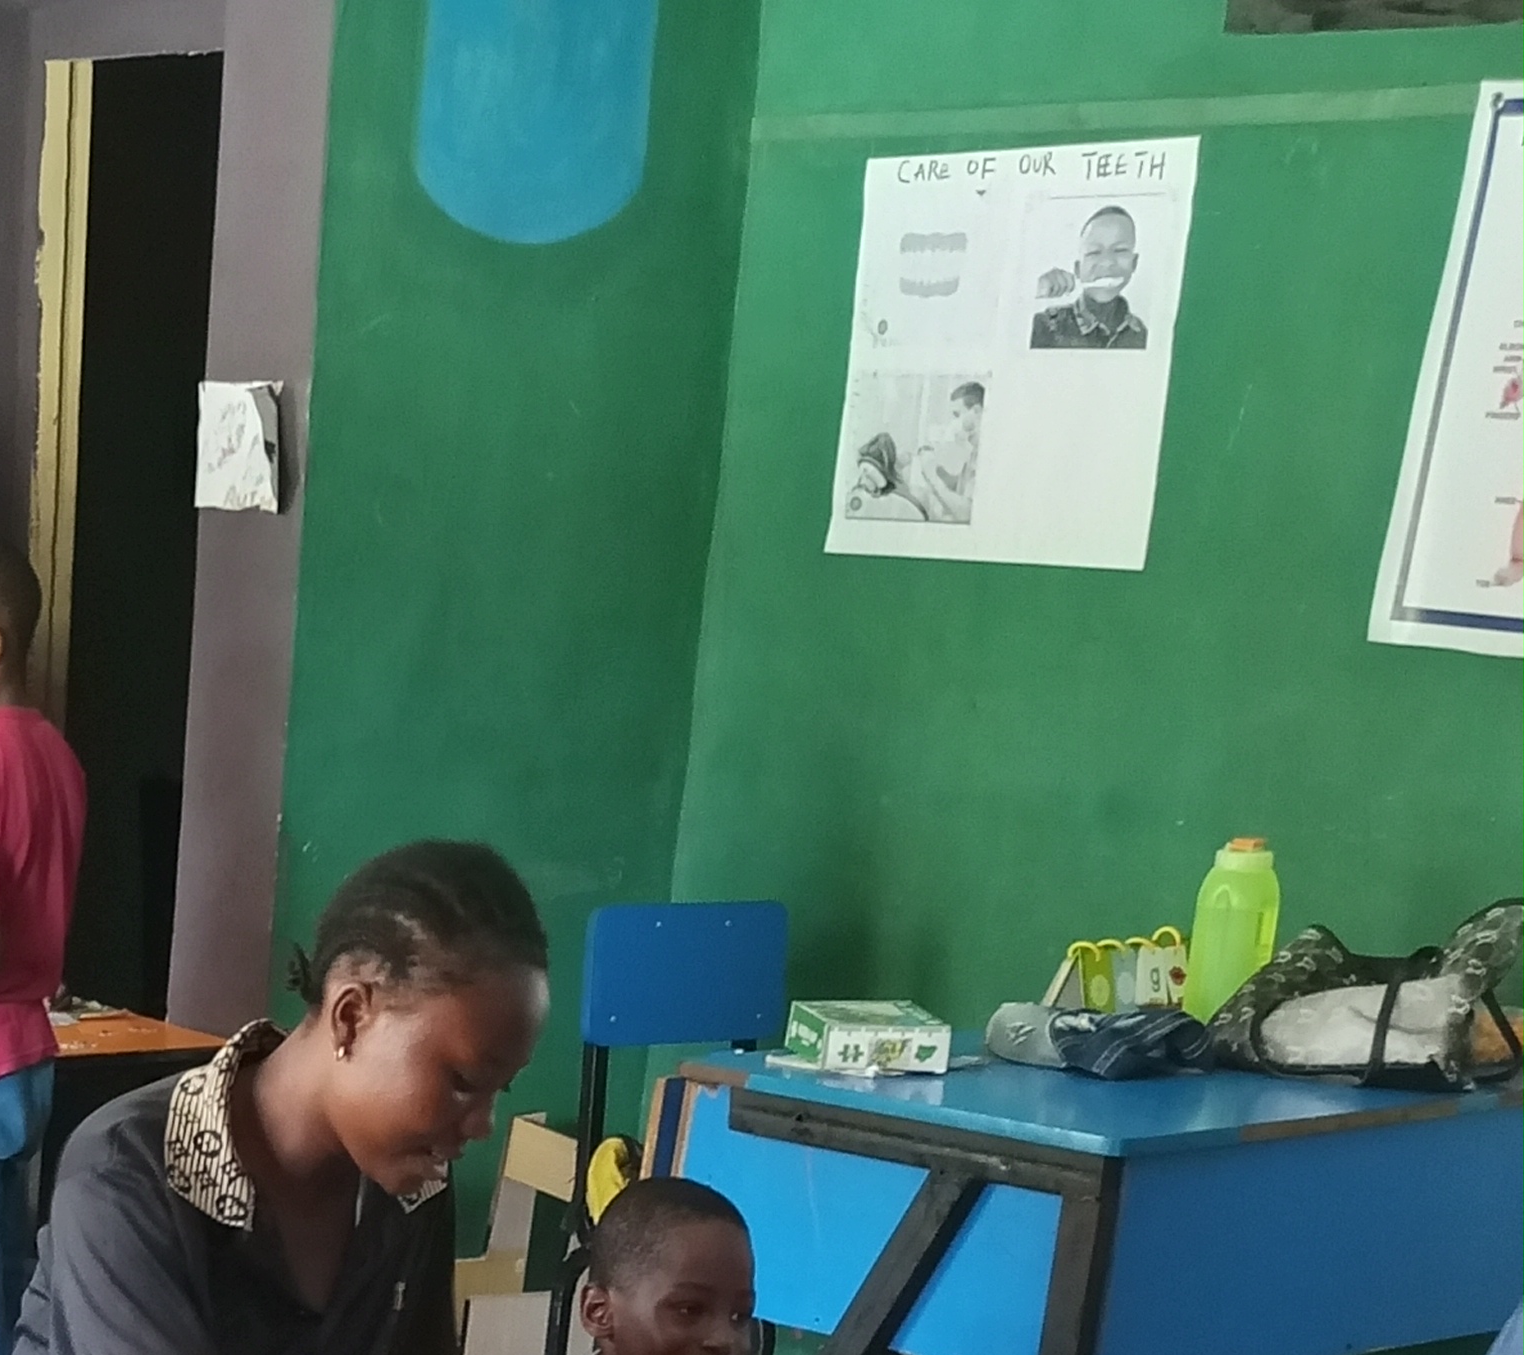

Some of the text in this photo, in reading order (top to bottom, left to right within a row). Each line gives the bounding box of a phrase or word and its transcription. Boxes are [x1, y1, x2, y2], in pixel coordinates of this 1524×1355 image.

[897, 151, 1166, 184] CARE OF OUR TEETH
